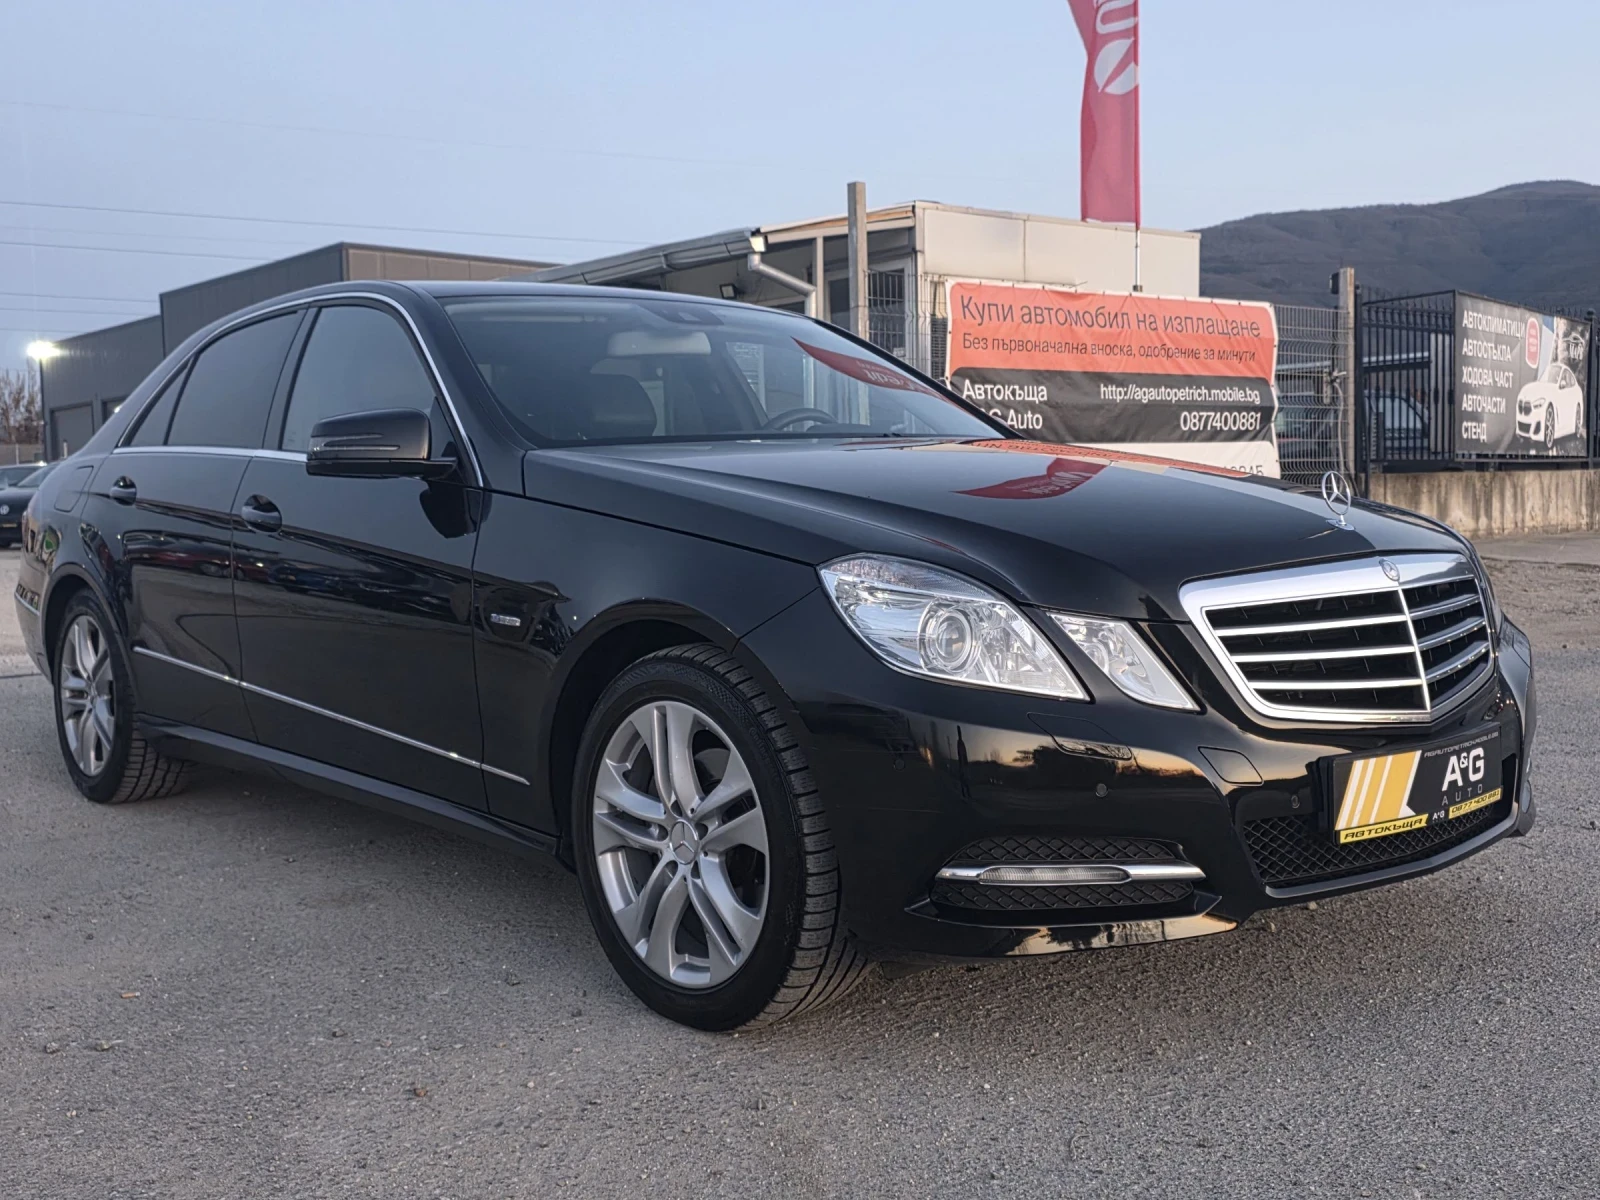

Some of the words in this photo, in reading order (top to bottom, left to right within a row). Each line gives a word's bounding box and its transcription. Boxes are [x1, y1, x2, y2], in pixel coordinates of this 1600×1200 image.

[960, 294, 1015, 327] Купи
[1020, 303, 1131, 330] автомобил
[1136, 312, 1158, 332] на
[1163, 314, 1261, 341] изплащане
[1462, 309, 1526, 341] АВТОКЛИМАТИЦИ
[963, 332, 989, 350] Без
[992, 337, 1088, 355] първоначална
[1091, 342, 1136, 358] вноска,
[1138, 343, 1201, 361] одобрение
[1203, 349, 1215, 361] за
[1217, 349, 1256, 365] минути
[1462, 338, 1512, 363] АВТОСТЪКЛА
[1462, 366, 1494, 389] ХОДОВА
[1495, 371, 1514, 389] ЧАСТ
[962, 379, 1048, 404] Автокъща
[1100, 383, 1261, 405] http://agautopetrich.mobile.bg
[1462, 394, 1506, 414] АВТОЧАСТИ
[1007, 409, 1043, 430] Auto
[1180, 411, 1261, 431] 0877400881
[1462, 421, 1487, 443] СТЕНД
[1441, 747, 1485, 792] A&G
[1441, 783, 1483, 806] AUTO
[1451, 801, 1473, 813] 0877
[1344, 818, 1423, 840] АВТОКЪЩА
